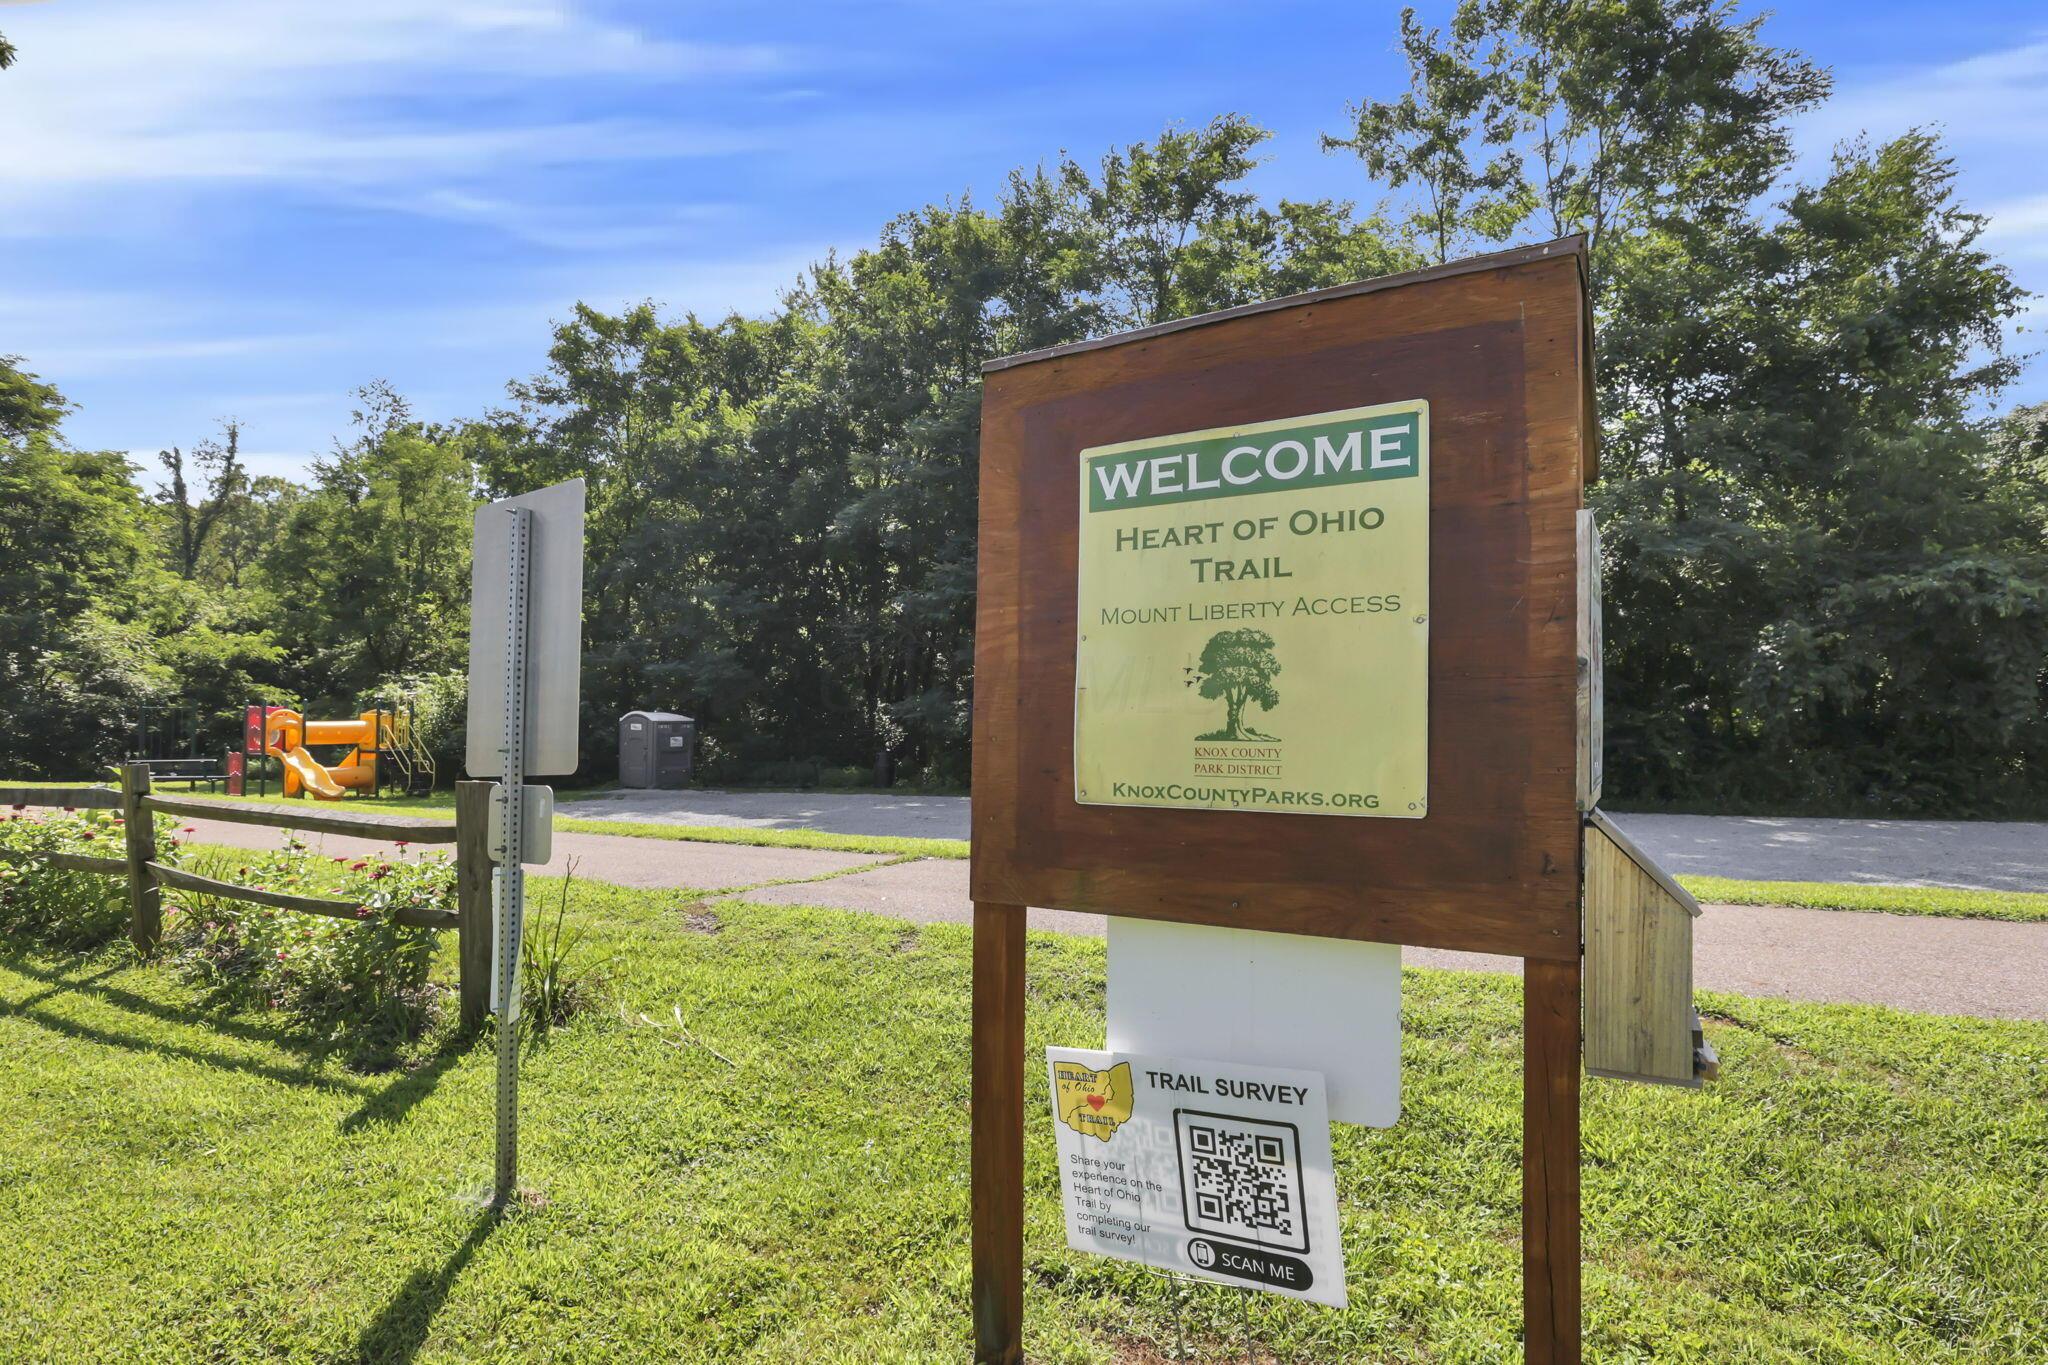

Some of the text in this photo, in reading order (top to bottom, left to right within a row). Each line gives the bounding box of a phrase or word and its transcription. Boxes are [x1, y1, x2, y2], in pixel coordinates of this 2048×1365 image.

[1095, 423, 1411, 501] WELCOME
[1116, 507, 1385, 552] HEART OF OHIO
[1190, 556, 1293, 583] TRAIL
[1101, 594, 1401, 625] MOUNT LIBERTY ACCESS
[1194, 747, 1282, 759] KNOX COUNTY
[1194, 763, 1282, 775] PARK DISTRICT
[1057, 1070, 1098, 1084] HEART
[1061, 1081, 1095, 1093] of Ohio
[1145, 1070, 1309, 1106] TRAIL SURVEY
[1078, 1113, 1116, 1127] TRAIL
[1070, 1154, 1126, 1171] Share your
[1072, 1170, 1163, 1192] experience on the
[1073, 1182, 1141, 1202] Heart of Ohio
[1075, 1195, 1112, 1213] Trail by
[1076, 1212, 1151, 1233] completing our
[1078, 1225, 1136, 1245] trail survey!
[1222, 1252, 1296, 1282] SCAN ME
